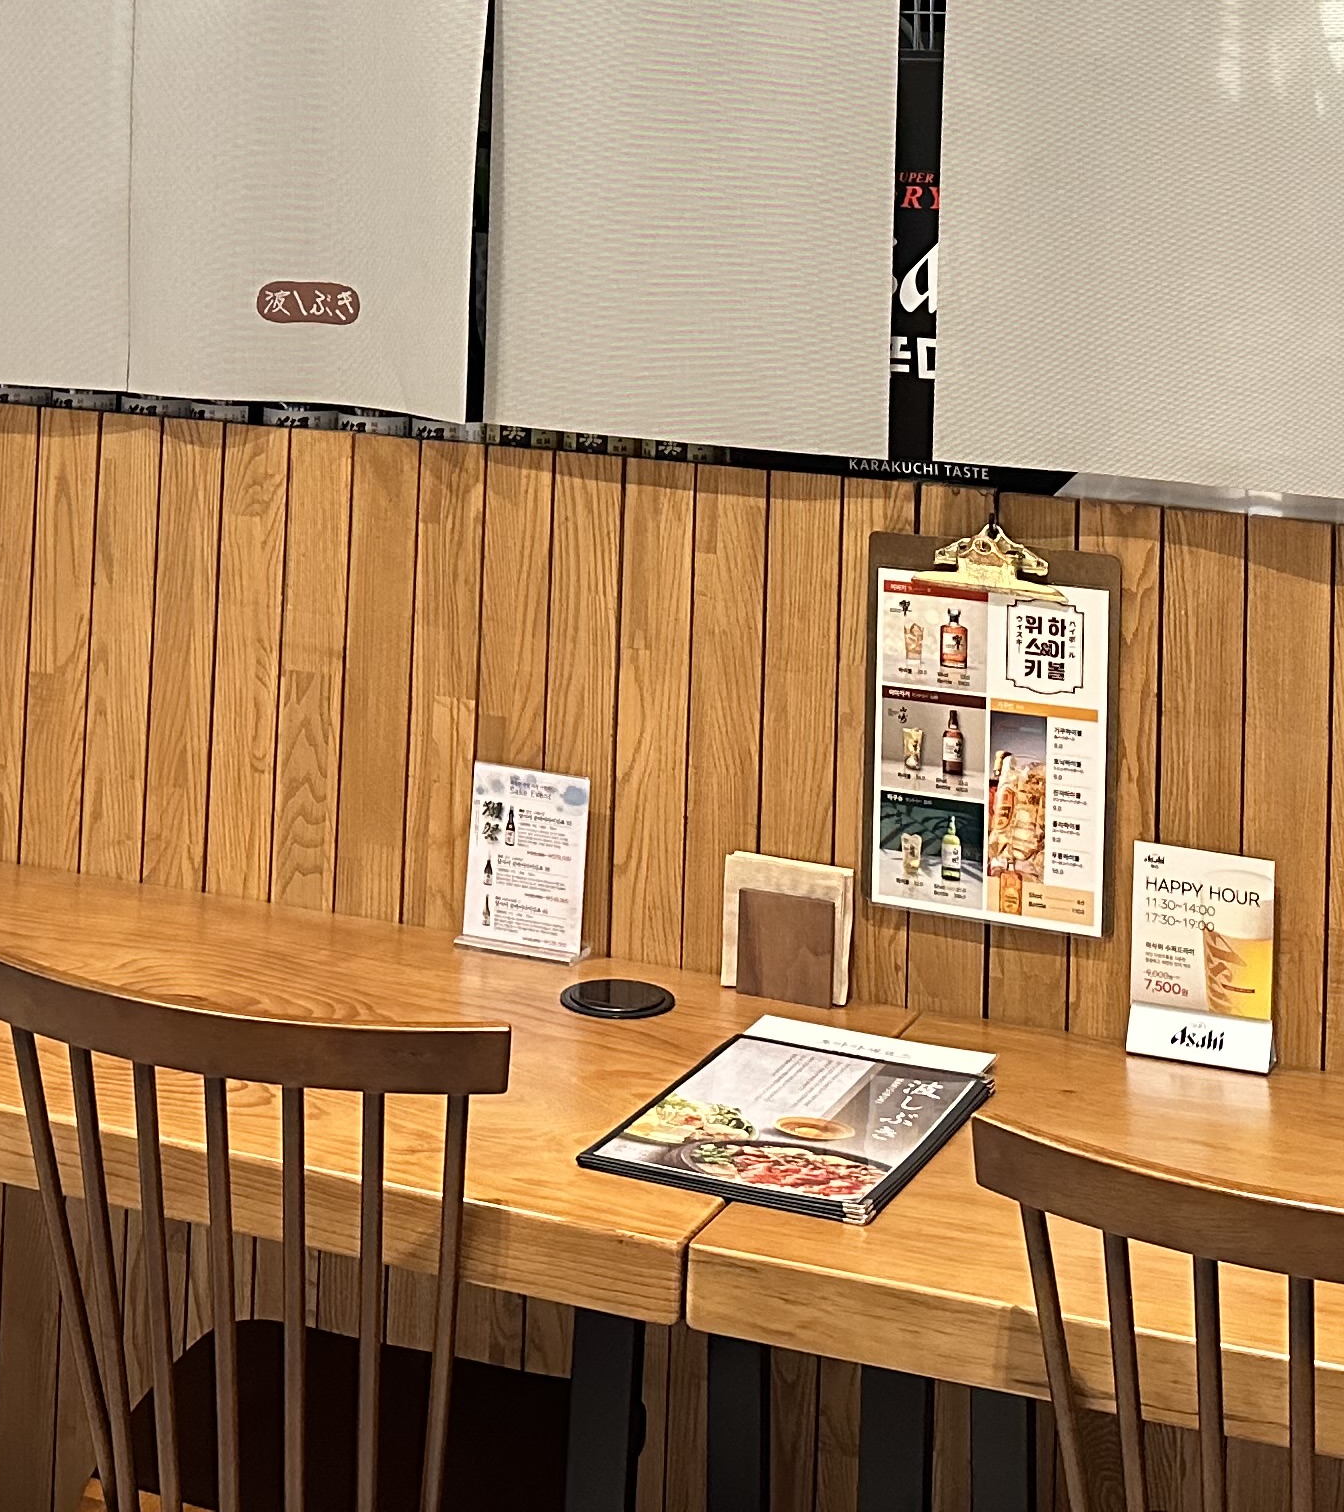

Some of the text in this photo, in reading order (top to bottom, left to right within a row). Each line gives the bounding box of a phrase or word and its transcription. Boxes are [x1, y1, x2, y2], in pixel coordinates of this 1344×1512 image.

[849, 457, 989, 480] KARAKUCHI TASTE
[1025, 615, 1043, 679] 위스키
[1048, 617, 1066, 680] 하이볼
[1146, 878, 1260, 907] HAPPY HOUR
[1171, 1027, 1224, 1051] Asahi
[872, 1078, 944, 1142] 波しぶき
